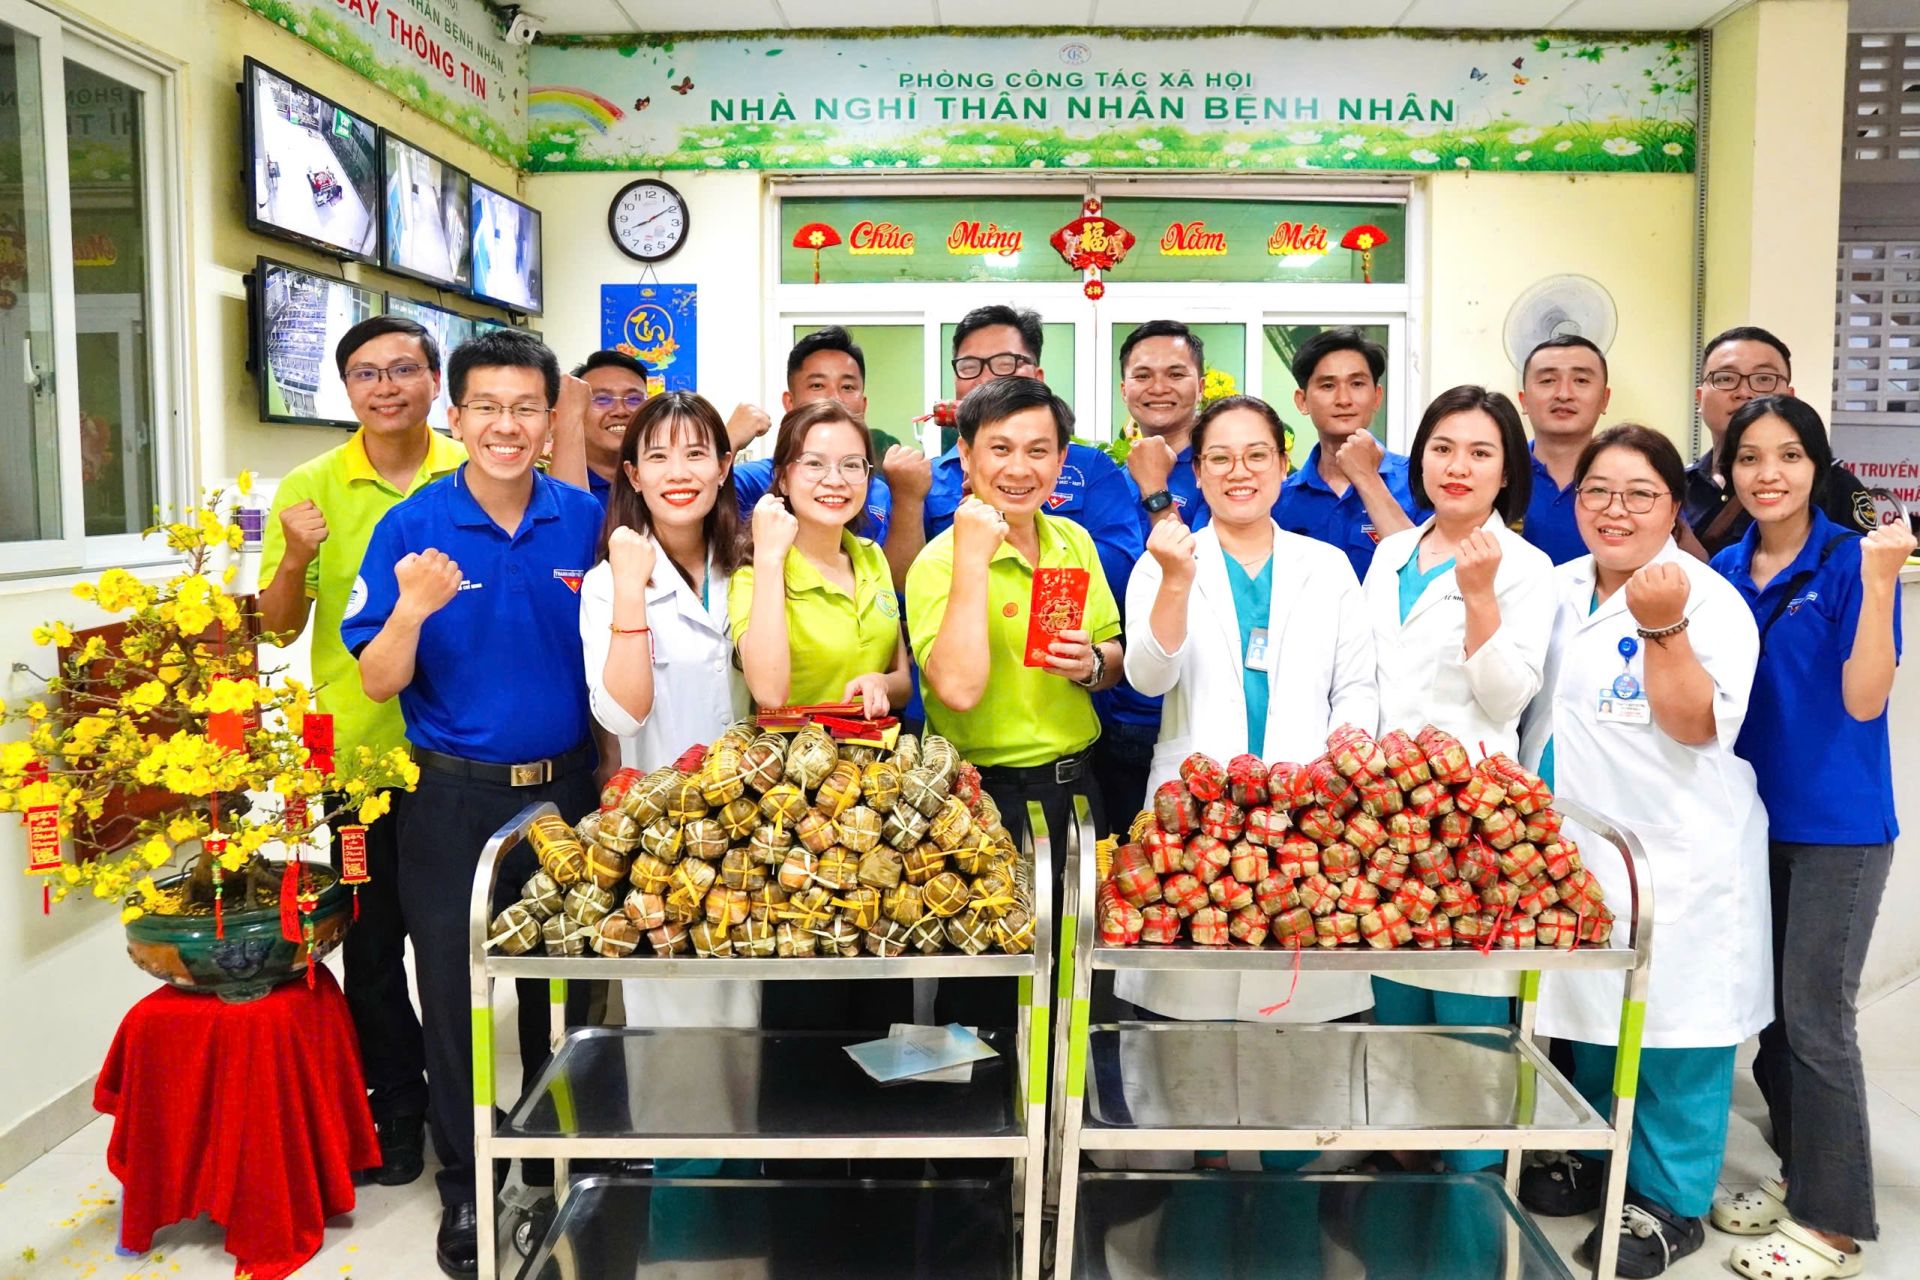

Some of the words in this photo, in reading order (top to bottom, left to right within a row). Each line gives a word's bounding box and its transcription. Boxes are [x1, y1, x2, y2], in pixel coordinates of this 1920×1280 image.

[386, 8, 455, 78] THÔNG
[460, 62, 487, 100] TIN
[899, 68, 995, 88] PHÒNG
[1005, 68, 1084, 88] CÔNG
[1095, 68, 1148, 88] TÁC
[1160, 67, 1195, 88] XÃ
[1206, 68, 1252, 91] HỘI
[710, 92, 796, 121] NHÀ
[815, 92, 916, 121] NGHỈ
[935, 91, 1047, 120] THÂN
[1068, 90, 1185, 120] NHÂN
[1204, 92, 1319, 125] BỆNH
[1339, 92, 1455, 122] NHÂN
[634, 193, 641, 201] 11
[645, 190, 657, 199] 12
[624, 203, 635, 211] 10
[668, 205, 677, 214] 2
[620, 215, 629, 223] 9
[671, 218, 680, 227] 3
[622, 229, 631, 237] 8
[667, 232, 675, 240] 4
[1080, 221, 1109, 252] 福
[632, 239, 640, 247] 7
[849, 220, 915, 251] Chúc
[947, 220, 1024, 257] Mừng
[1160, 221, 1227, 251] Năm
[1268, 221, 1329, 252] Mới
[643, 244, 653, 252] 6
[657, 241, 666, 249] 5
[1859, 458, 1919, 478] TRUYỀN
